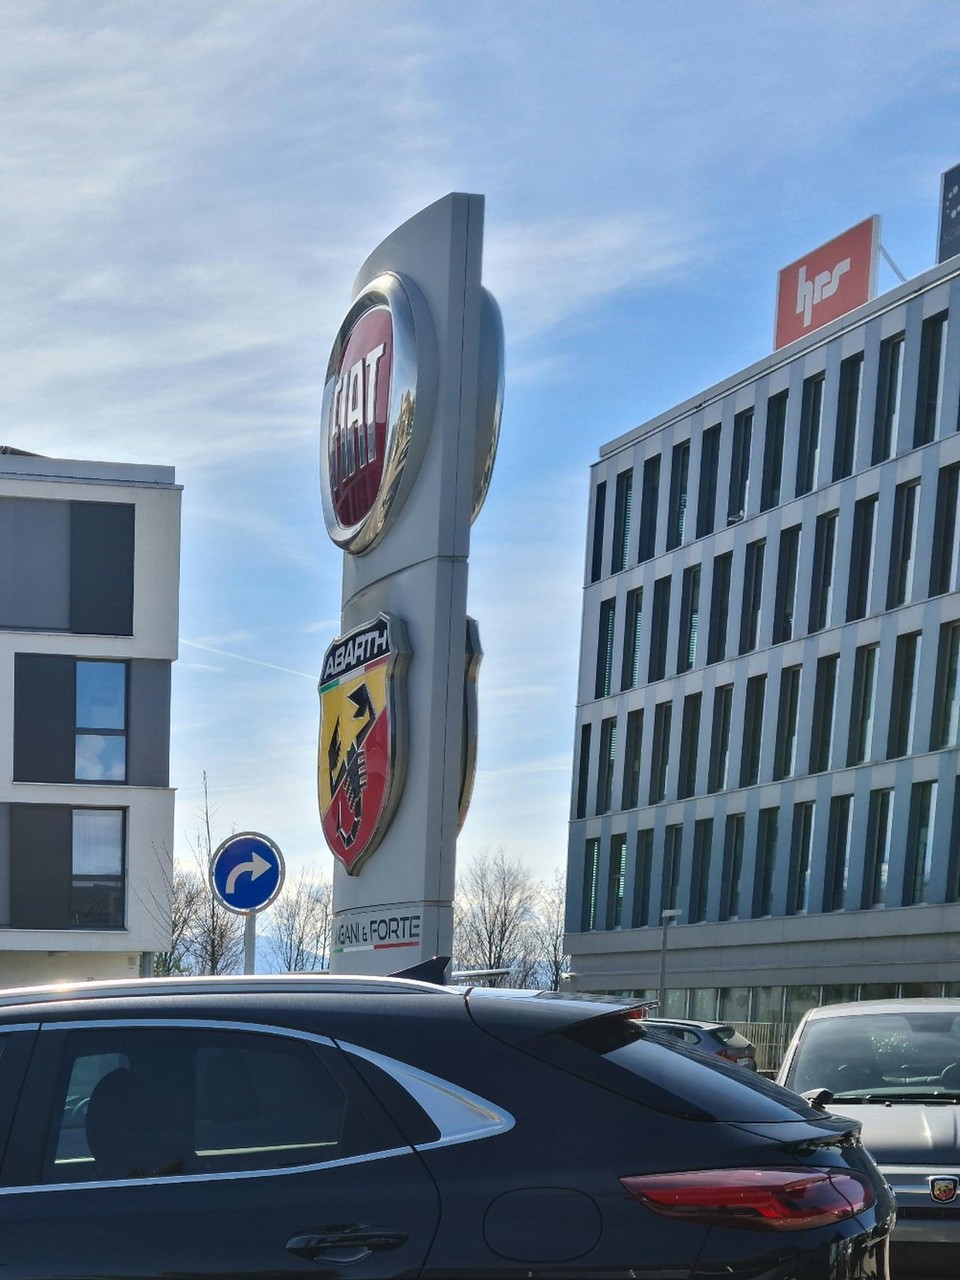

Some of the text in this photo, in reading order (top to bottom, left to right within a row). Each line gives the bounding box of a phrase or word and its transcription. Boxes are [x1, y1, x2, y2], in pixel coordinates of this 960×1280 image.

[796, 257, 851, 328] hrs
[330, 342, 384, 492] FIAT
[324, 629, 387, 679] ABARTH
[362, 926, 368, 942] &
[369, 915, 421, 941] FORTE
